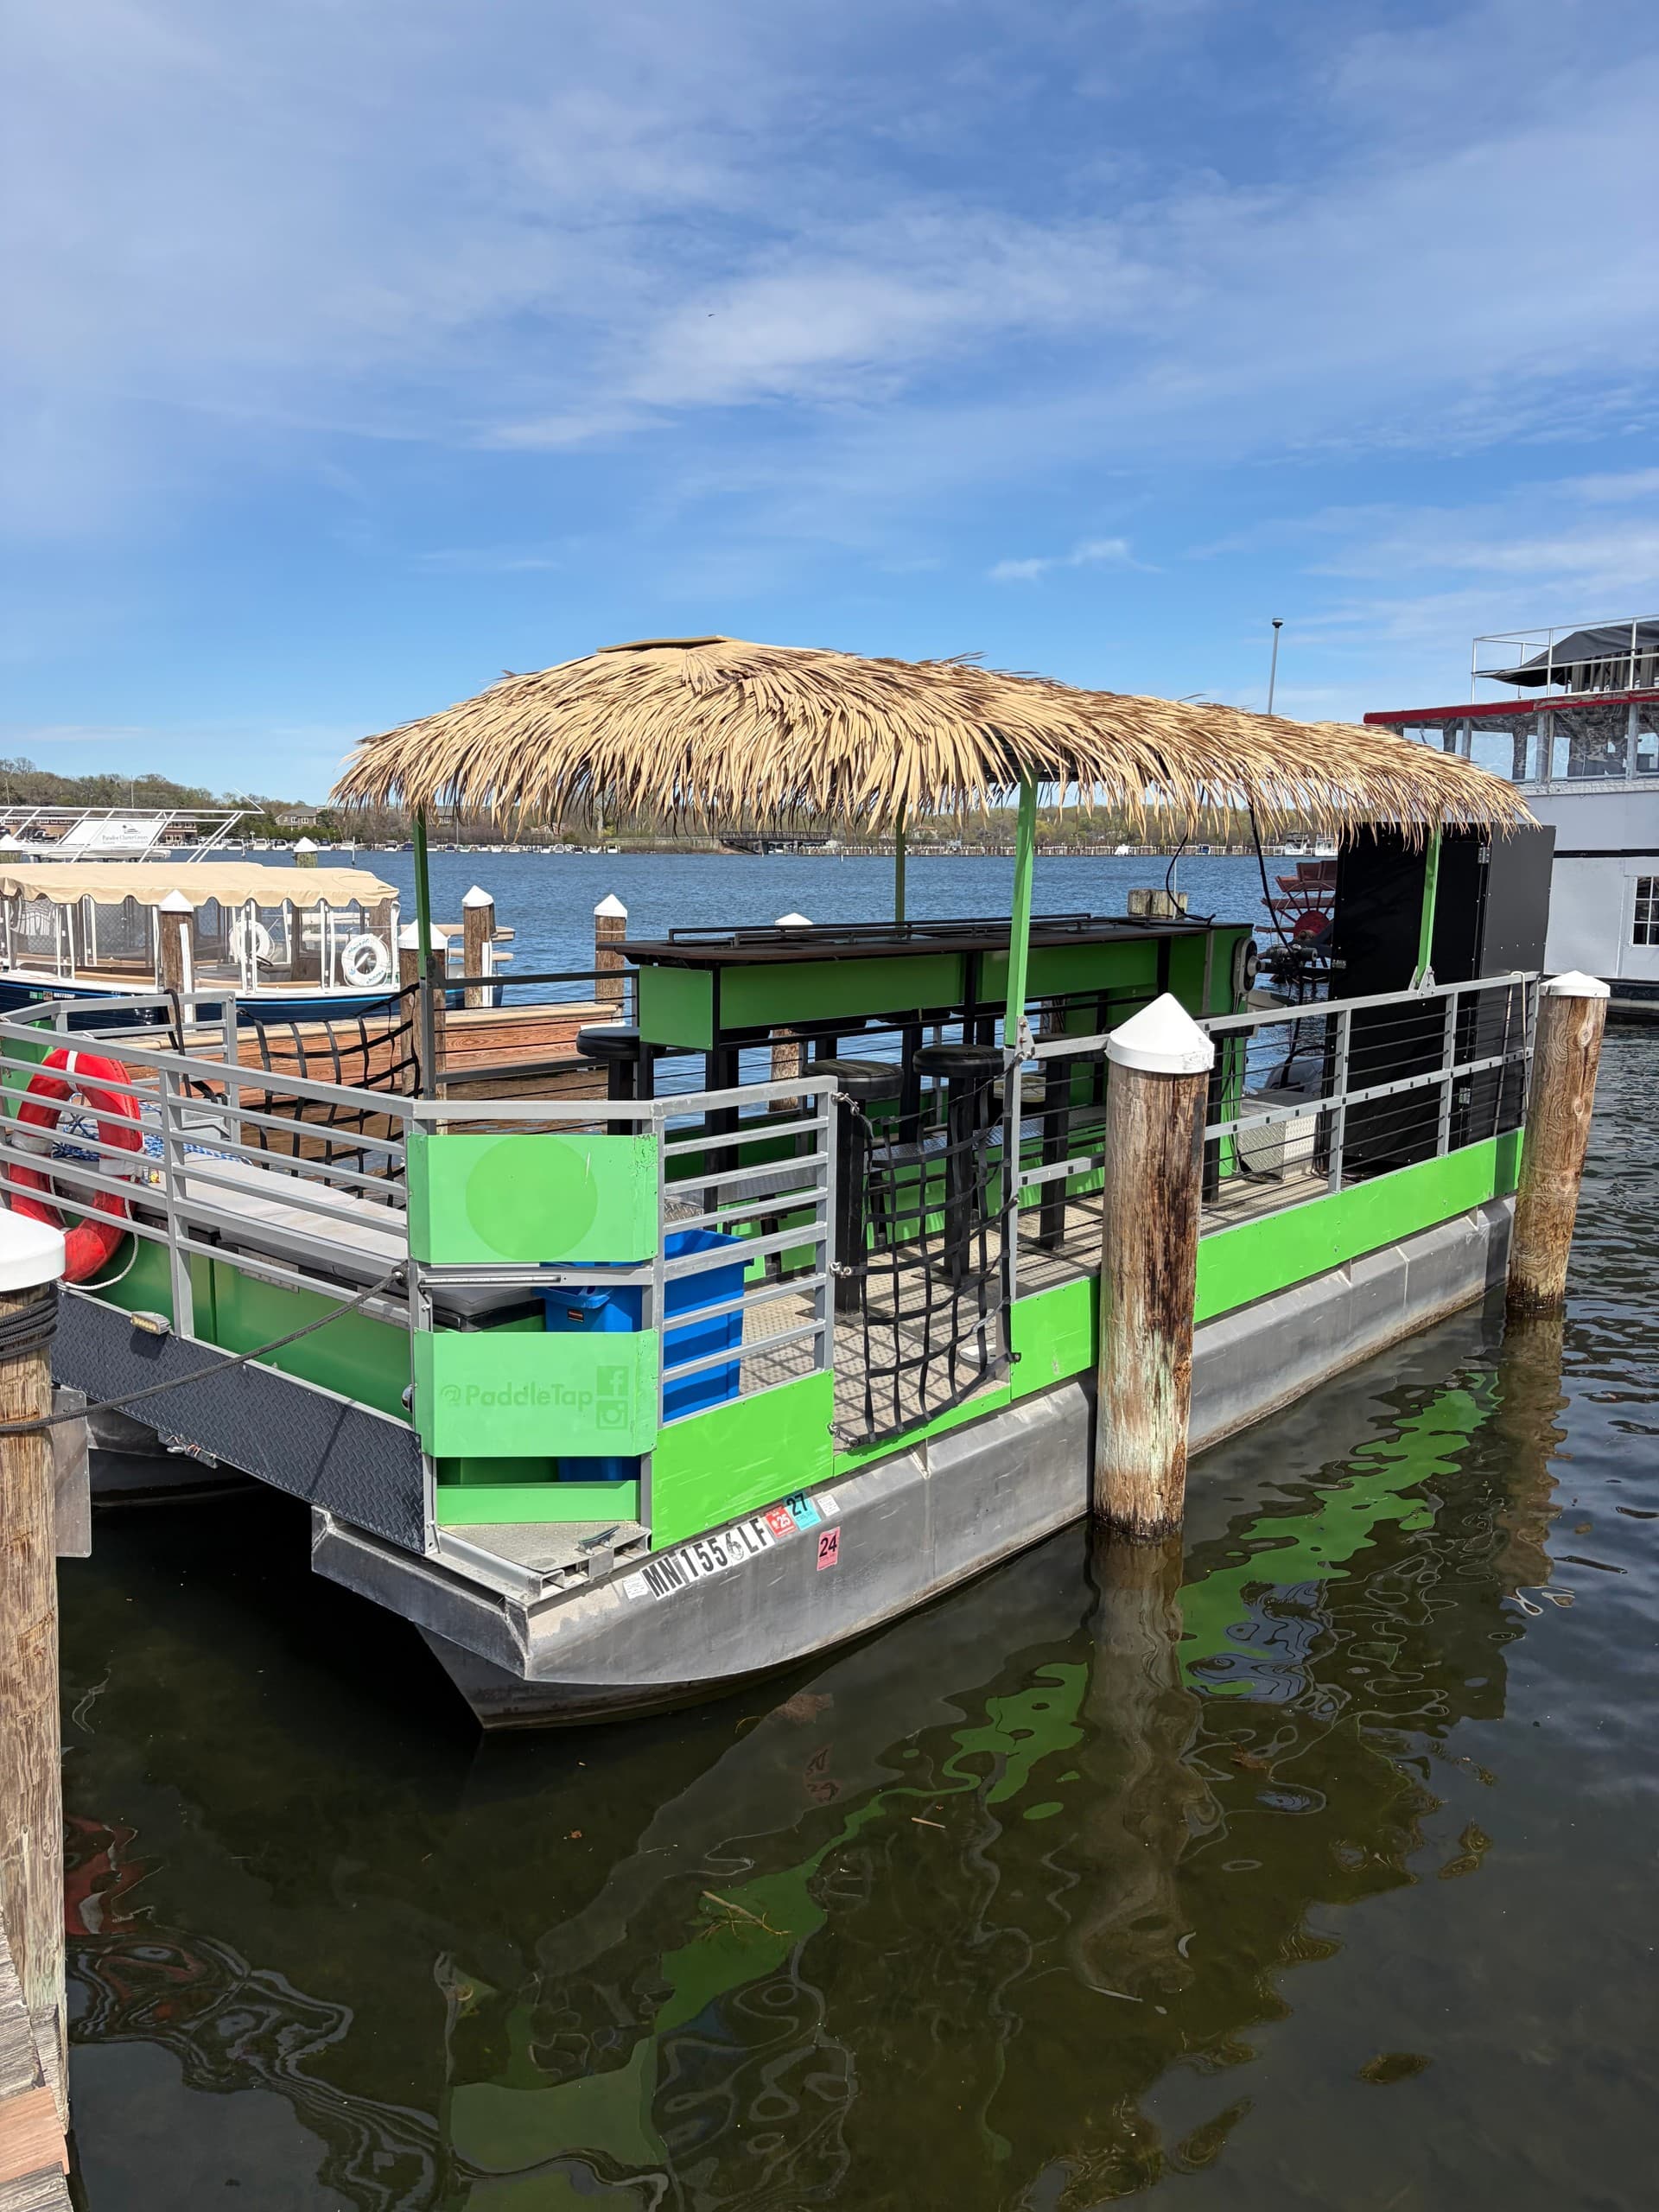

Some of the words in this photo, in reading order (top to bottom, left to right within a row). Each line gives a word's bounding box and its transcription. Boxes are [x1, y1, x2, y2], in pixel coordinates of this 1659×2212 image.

[441, 1382, 594, 1412] @PaddleTap
[786, 1492, 808, 1517] 27
[777, 1513, 791, 1528] 25
[641, 1557, 683, 1598] MN
[680, 1532, 745, 1578] 1556
[737, 1517, 766, 1554] LF
[819, 1534, 837, 1557] 24
